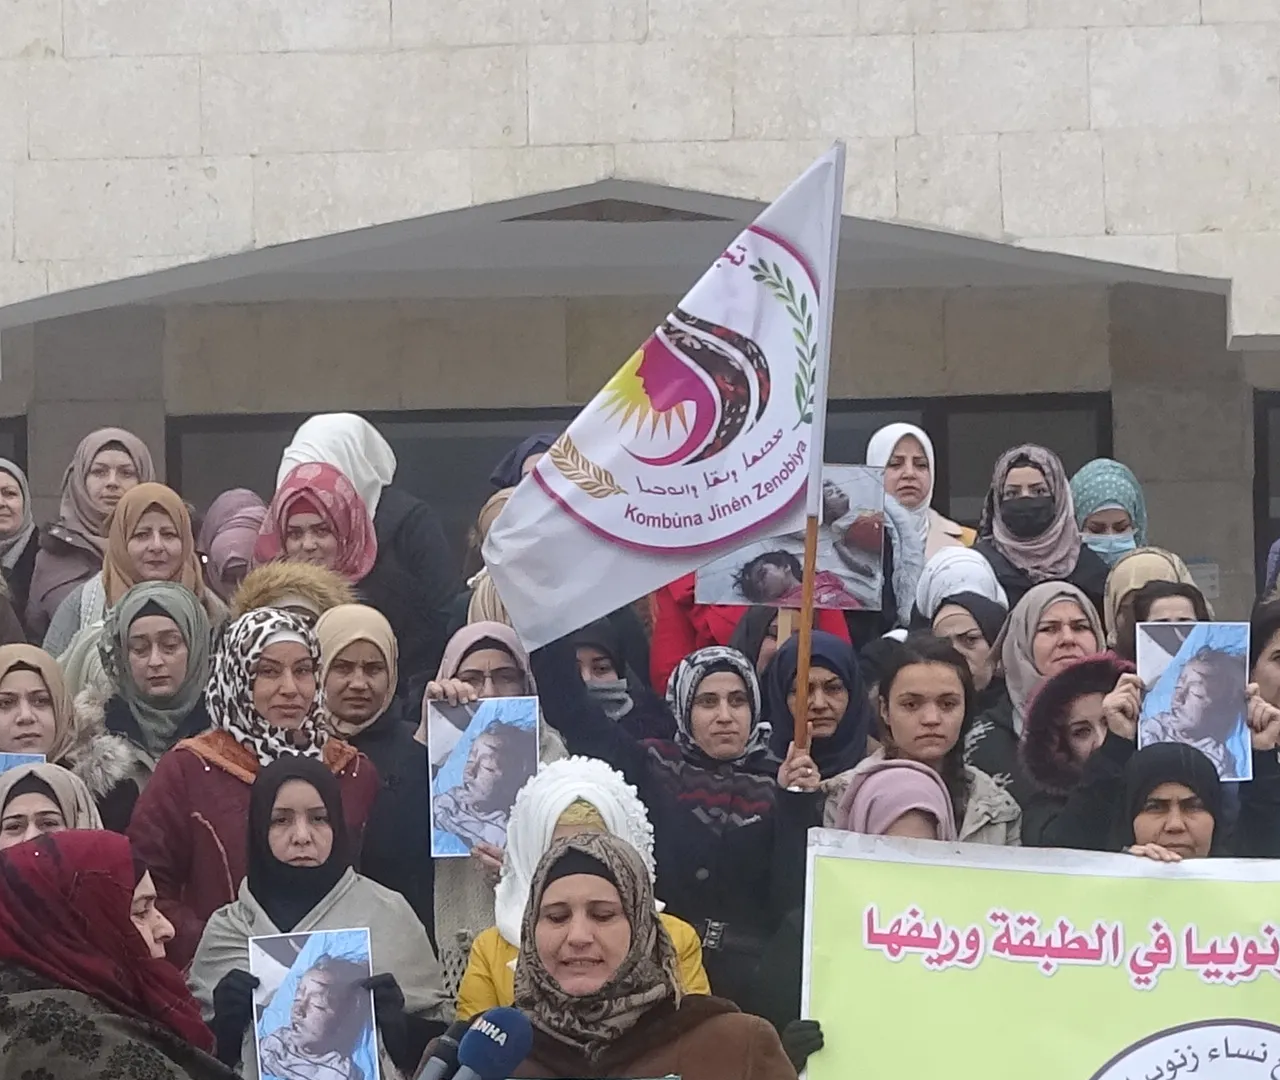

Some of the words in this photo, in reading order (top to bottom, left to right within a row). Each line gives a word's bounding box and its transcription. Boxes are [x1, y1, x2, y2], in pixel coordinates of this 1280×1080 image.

[708, 493, 753, 522] Jinên
[752, 439, 808, 501] Zenobiya
[866, 906, 980, 966] وريفها
[988, 910, 1120, 972] الطبقة
[1128, 921, 1172, 986] في
[1207, 1036, 1269, 1063] نساء
